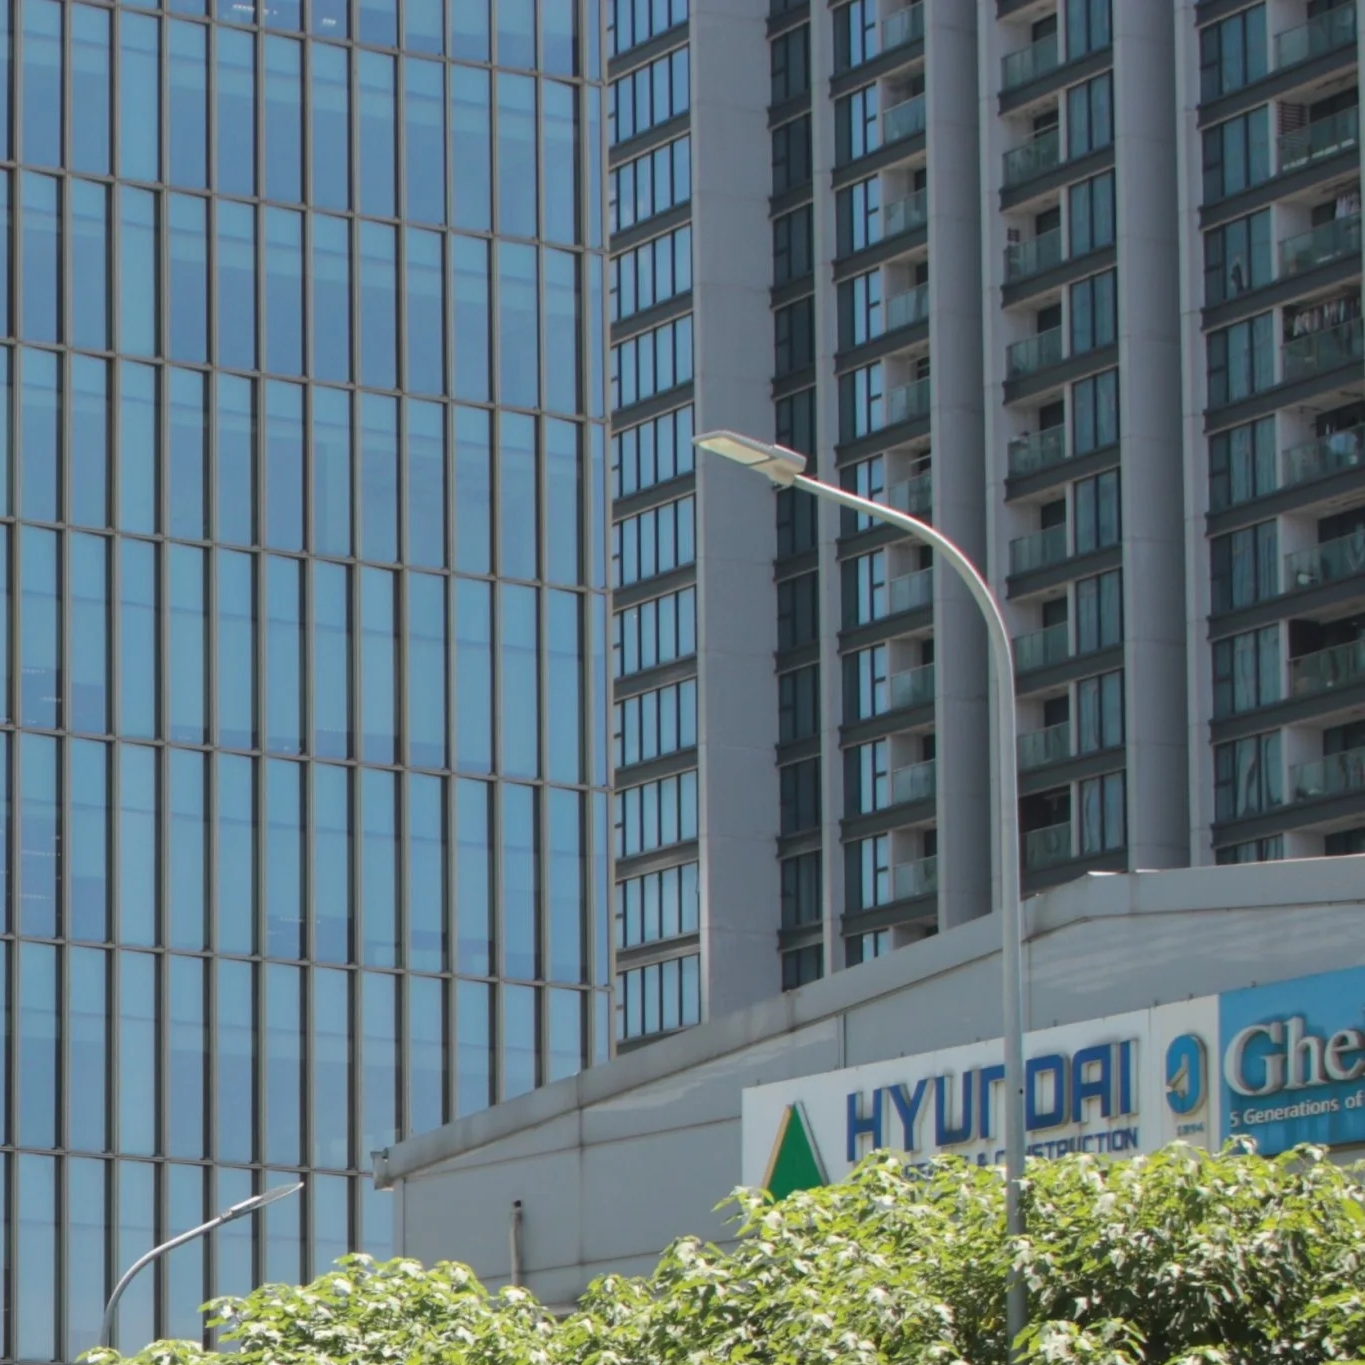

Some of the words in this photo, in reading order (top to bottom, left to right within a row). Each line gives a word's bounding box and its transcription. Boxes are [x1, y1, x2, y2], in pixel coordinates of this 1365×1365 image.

[846, 1039, 1138, 1162] HYUNDAI
[1243, 1099, 1339, 1126] Generations
[1345, 1091, 1364, 1111] of
[994, 1126, 1138, 1165] CSTRUCTION
